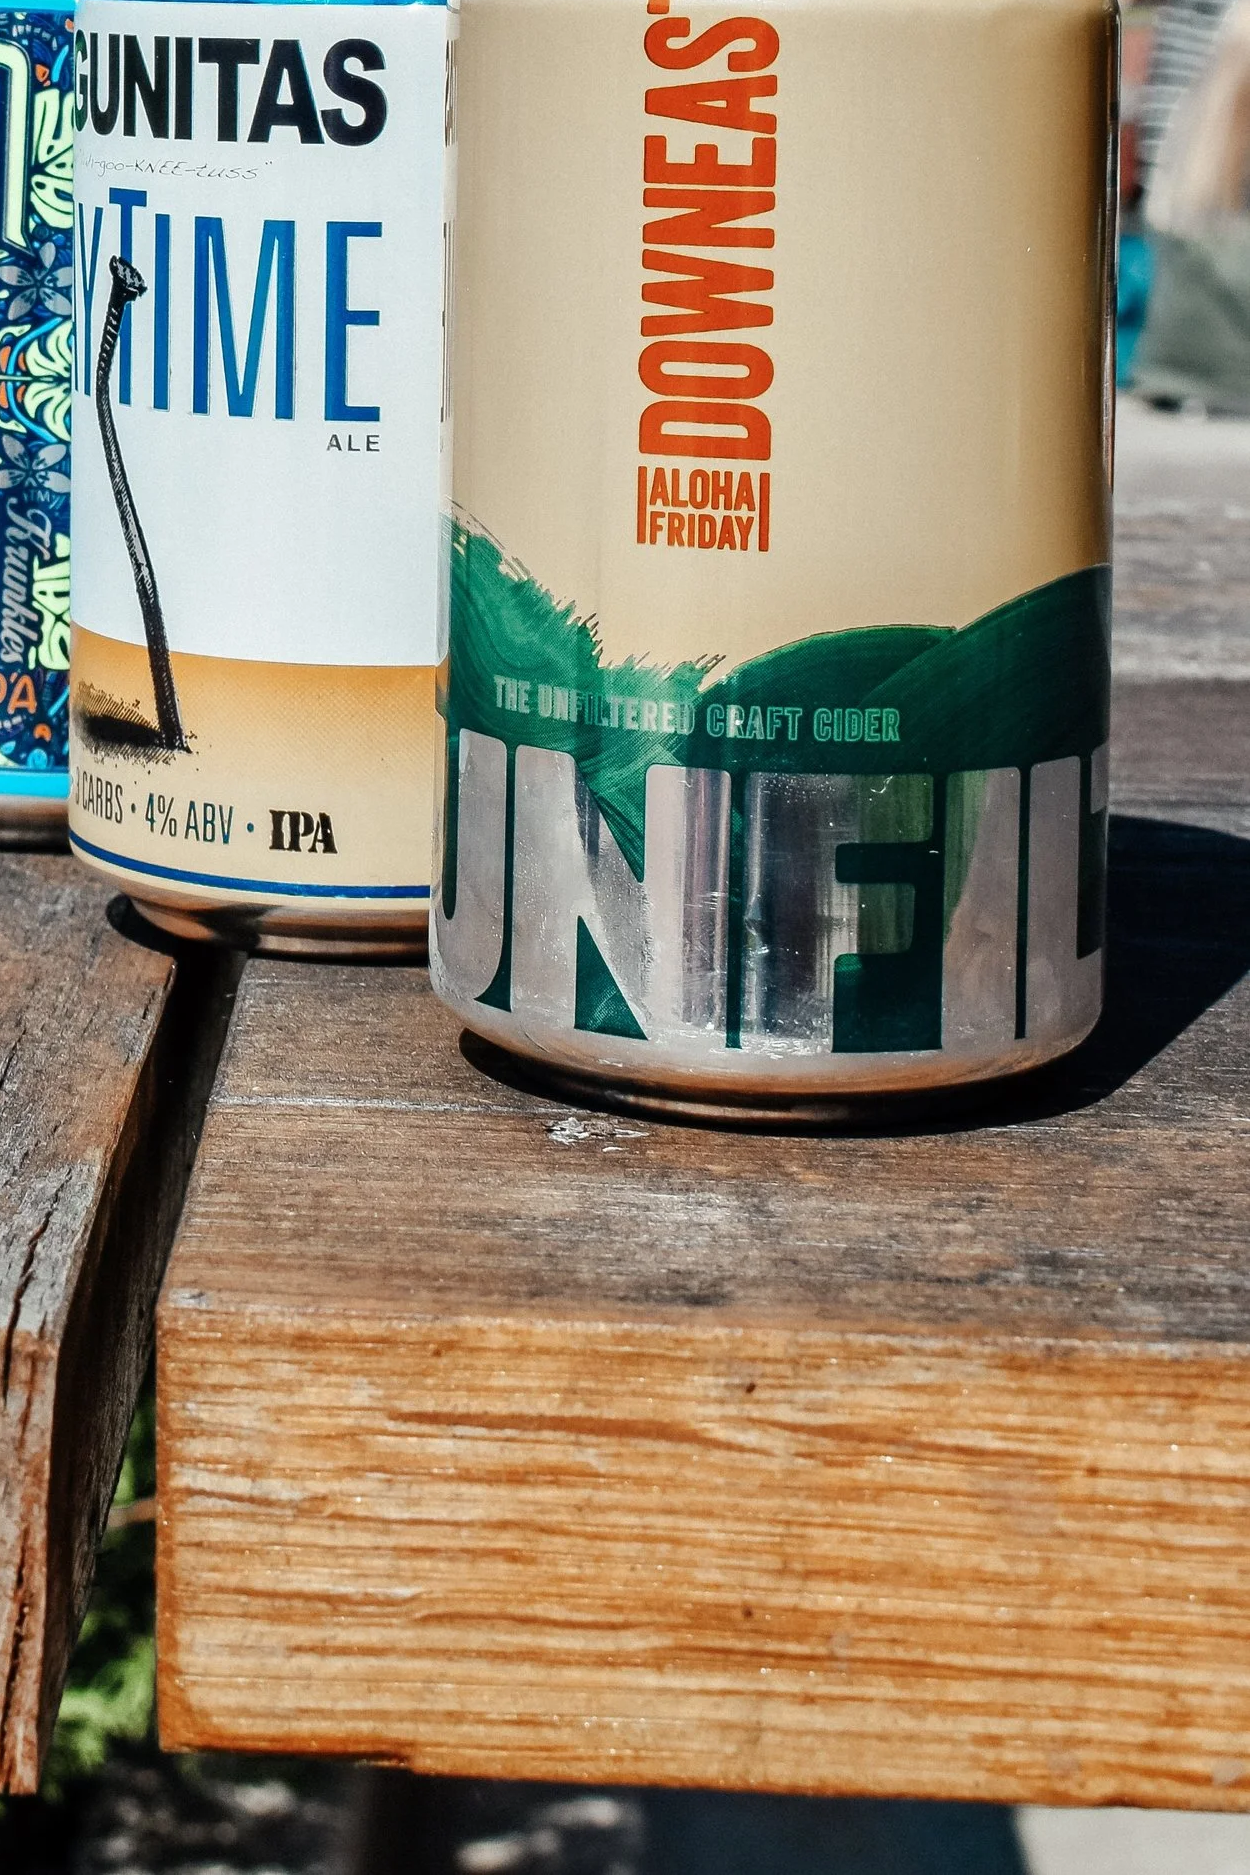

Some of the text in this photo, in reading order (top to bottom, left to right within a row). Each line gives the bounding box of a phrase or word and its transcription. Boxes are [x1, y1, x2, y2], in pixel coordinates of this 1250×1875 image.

[74, 28, 389, 147] GUNITAS
[72, 187, 383, 423] YTIME
[326, 434, 381, 453] ALE
[649, 466, 756, 512] ALOHA
[649, 510, 755, 552] FRIDAY
[0, 496, 52, 665] Krunkles
[493, 676, 902, 743] THE UNFILTERED CRAFT CIDER
[82, 771, 124, 825] CARBS
[145, 792, 178, 838] 4%
[184, 800, 234, 846] ABV
[268, 809, 338, 854] IPA
